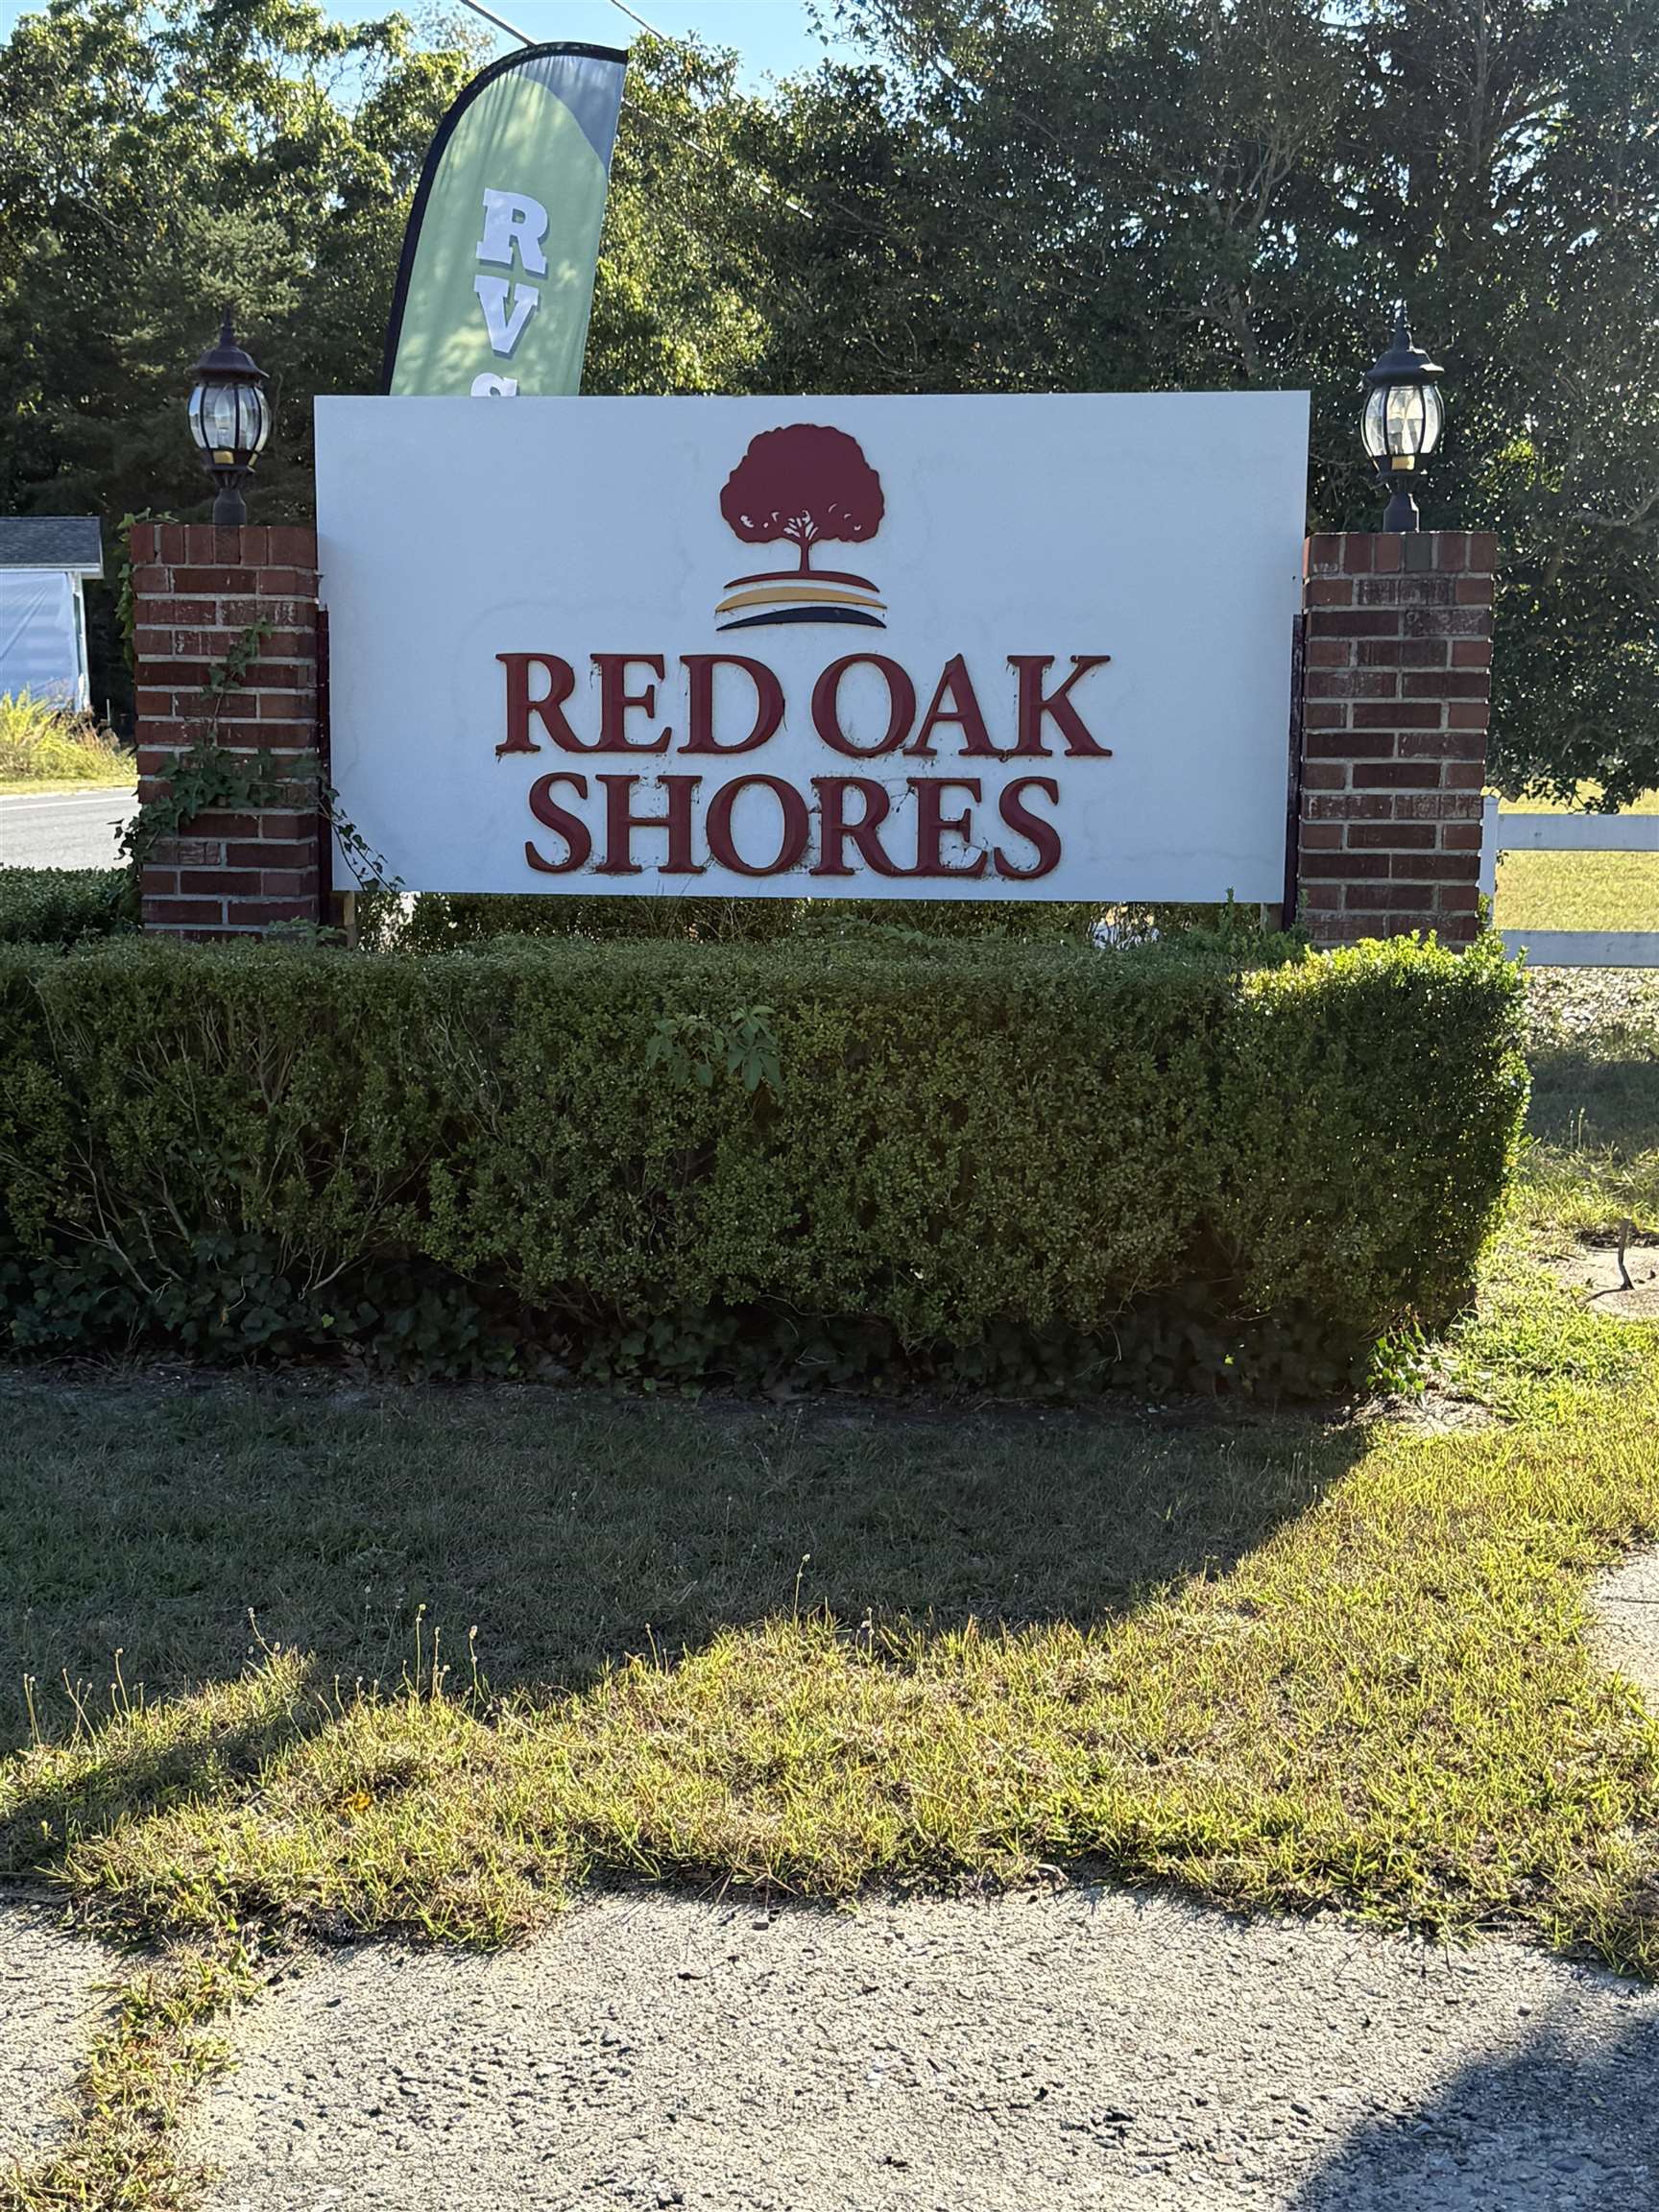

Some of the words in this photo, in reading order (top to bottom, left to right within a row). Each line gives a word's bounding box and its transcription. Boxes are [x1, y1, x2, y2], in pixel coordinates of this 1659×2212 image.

[495, 653, 785, 754] RED
[811, 653, 1113, 757] OAK
[525, 771, 1062, 880] SHORES
